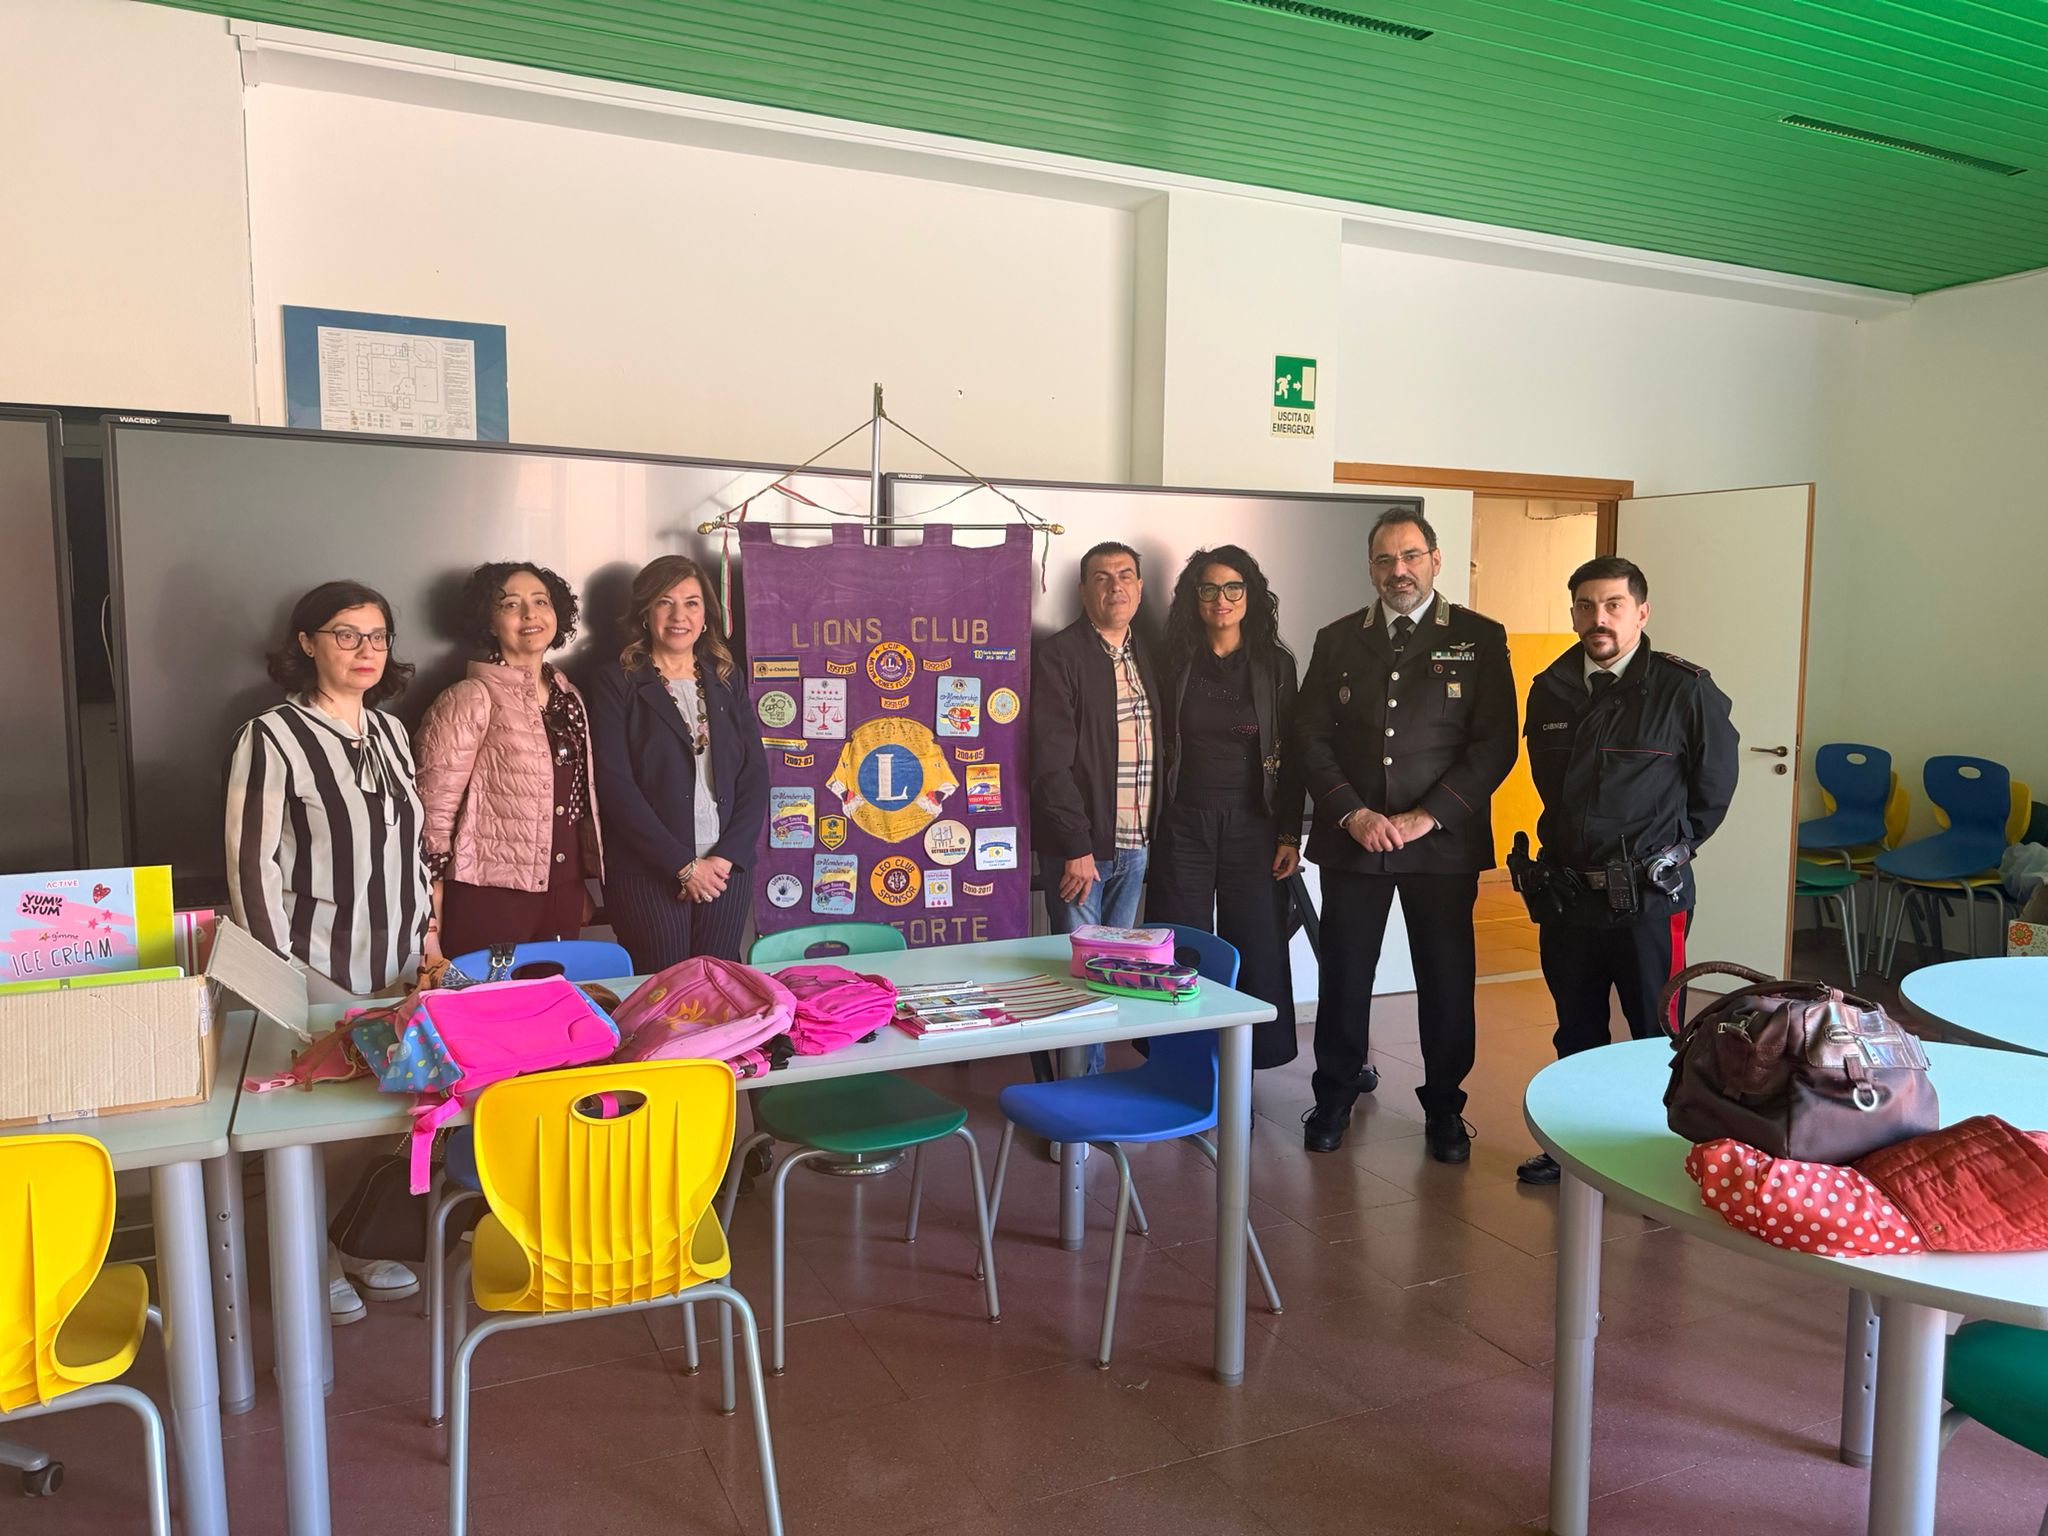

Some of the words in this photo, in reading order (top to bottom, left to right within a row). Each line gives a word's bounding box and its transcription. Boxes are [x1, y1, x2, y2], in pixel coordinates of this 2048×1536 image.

[1277, 411, 1302, 422] USCITA
[1303, 413, 1311, 422] DI
[1272, 423, 1314, 434] EMERGENZA
[791, 617, 882, 648] LIONS
[911, 616, 988, 644] CLUB
[882, 643, 901, 651] LCIF
[957, 749, 982, 760] 2004-05
[876, 754, 908, 800] L
[875, 861, 891, 877] LEO
[895, 859, 915, 873] CLUB
[47, 880, 78, 889] ACTIVE
[964, 884, 992, 894] 2010-2011
[25, 894, 56, 906] YUM
[878, 886, 917, 904] SPONSOR
[29, 905, 60, 916] YUM
[52, 931, 79, 941] gimme
[12, 951, 44, 977] ICE
[51, 937, 113, 967] CREAM
